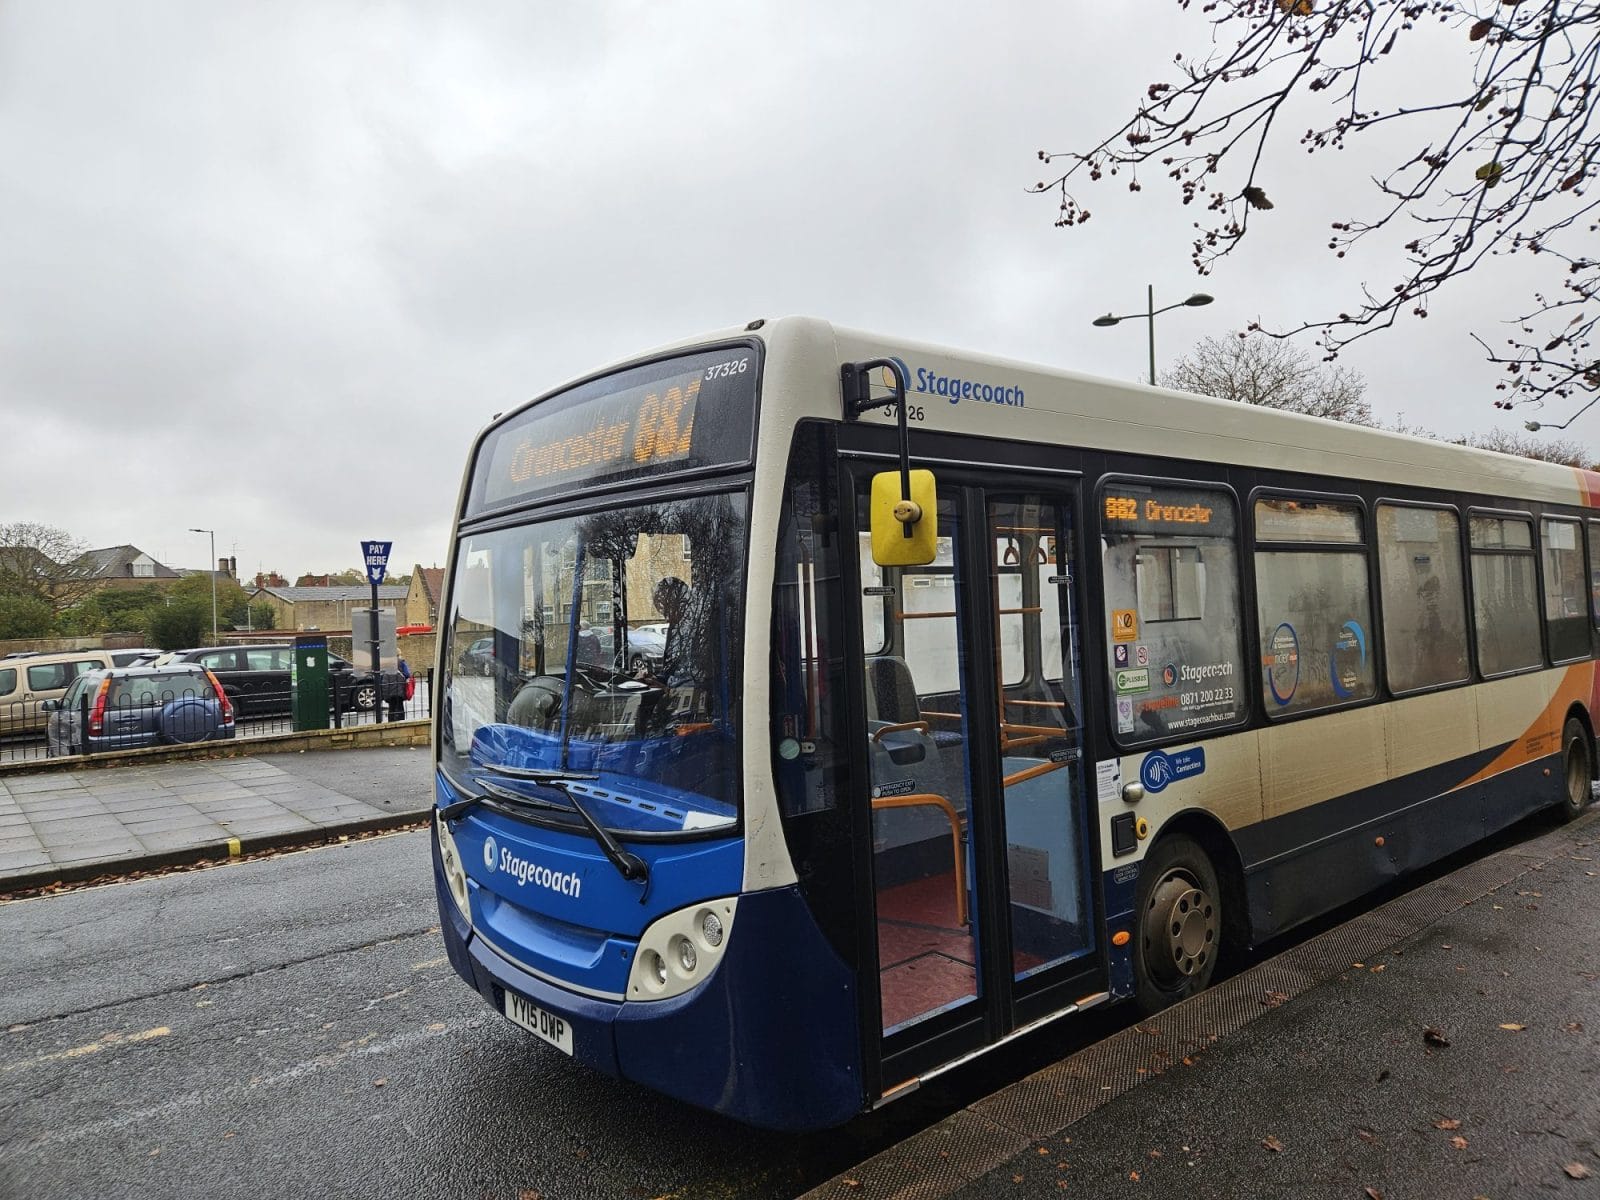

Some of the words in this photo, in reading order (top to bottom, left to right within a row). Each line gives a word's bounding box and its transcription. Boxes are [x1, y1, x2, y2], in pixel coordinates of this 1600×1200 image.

[704, 357, 749, 381] 37326
[916, 367, 1025, 408] Stagecoach
[883, 402, 925, 421] 3726
[368, 544, 385, 555] PAY
[366, 555, 388, 566] HERE
[1181, 661, 1232, 683] Stagecoach
[1180, 692, 1199, 706] 0871
[1200, 690, 1214, 703] 200
[1214, 688, 1224, 701] 22
[1224, 687, 1234, 699] 33
[1168, 712, 1235, 729] www.stagecoachbus.com
[881, 783, 904, 791] EMERGENCY
[500, 848, 581, 898] Stagecoach
[511, 994, 538, 1029] YY15
[540, 1011, 563, 1043] OWP
